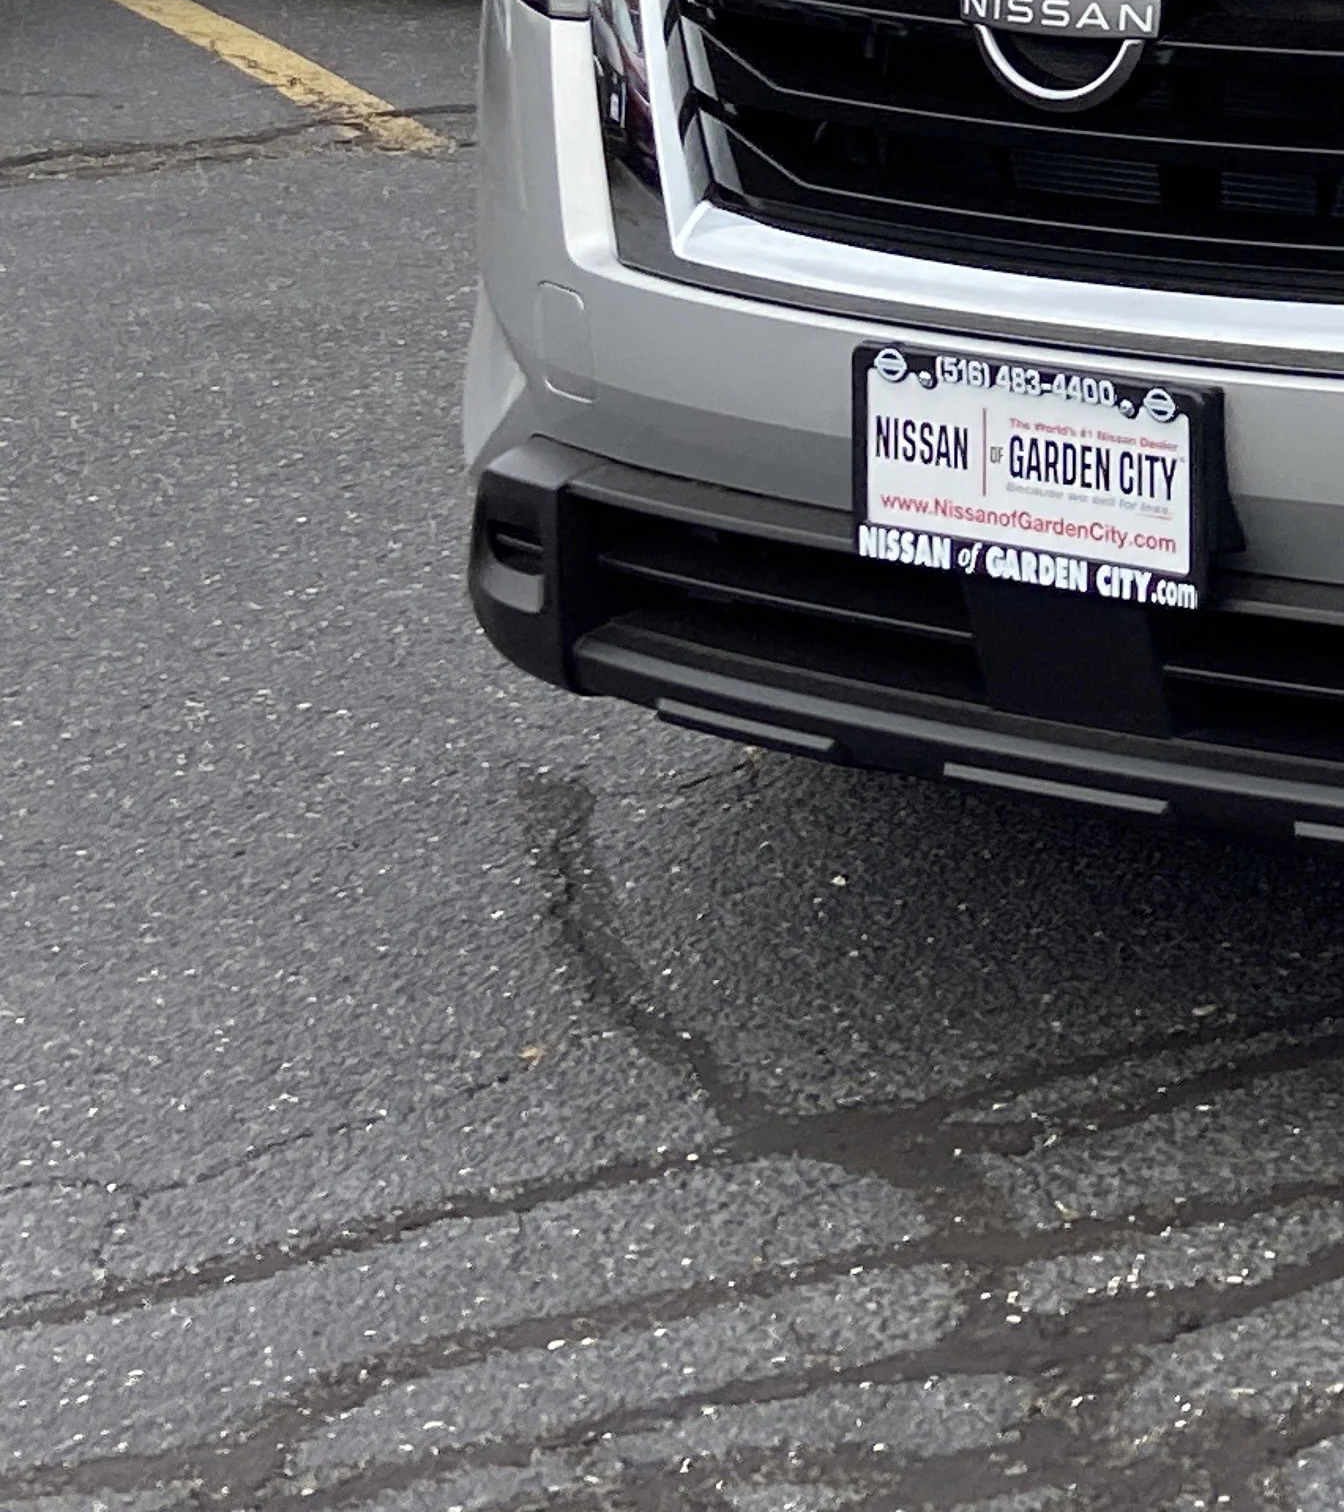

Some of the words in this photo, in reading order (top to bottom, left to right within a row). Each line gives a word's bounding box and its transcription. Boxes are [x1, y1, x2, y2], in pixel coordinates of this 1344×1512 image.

[935, 356, 990, 388] (516)
[995, 365, 1116, 407] 483-4400
[875, 415, 968, 471] NISSAN
[990, 446, 1004, 463] OF
[1009, 435, 1111, 492] GARDEN
[1119, 450, 1177, 501] CITY
[880, 492, 1177, 553] www.NissanofGardenCity.com
[859, 525, 951, 570] NISSAN
[958, 542, 983, 575] of
[985, 546, 1088, 593] GARDEN
